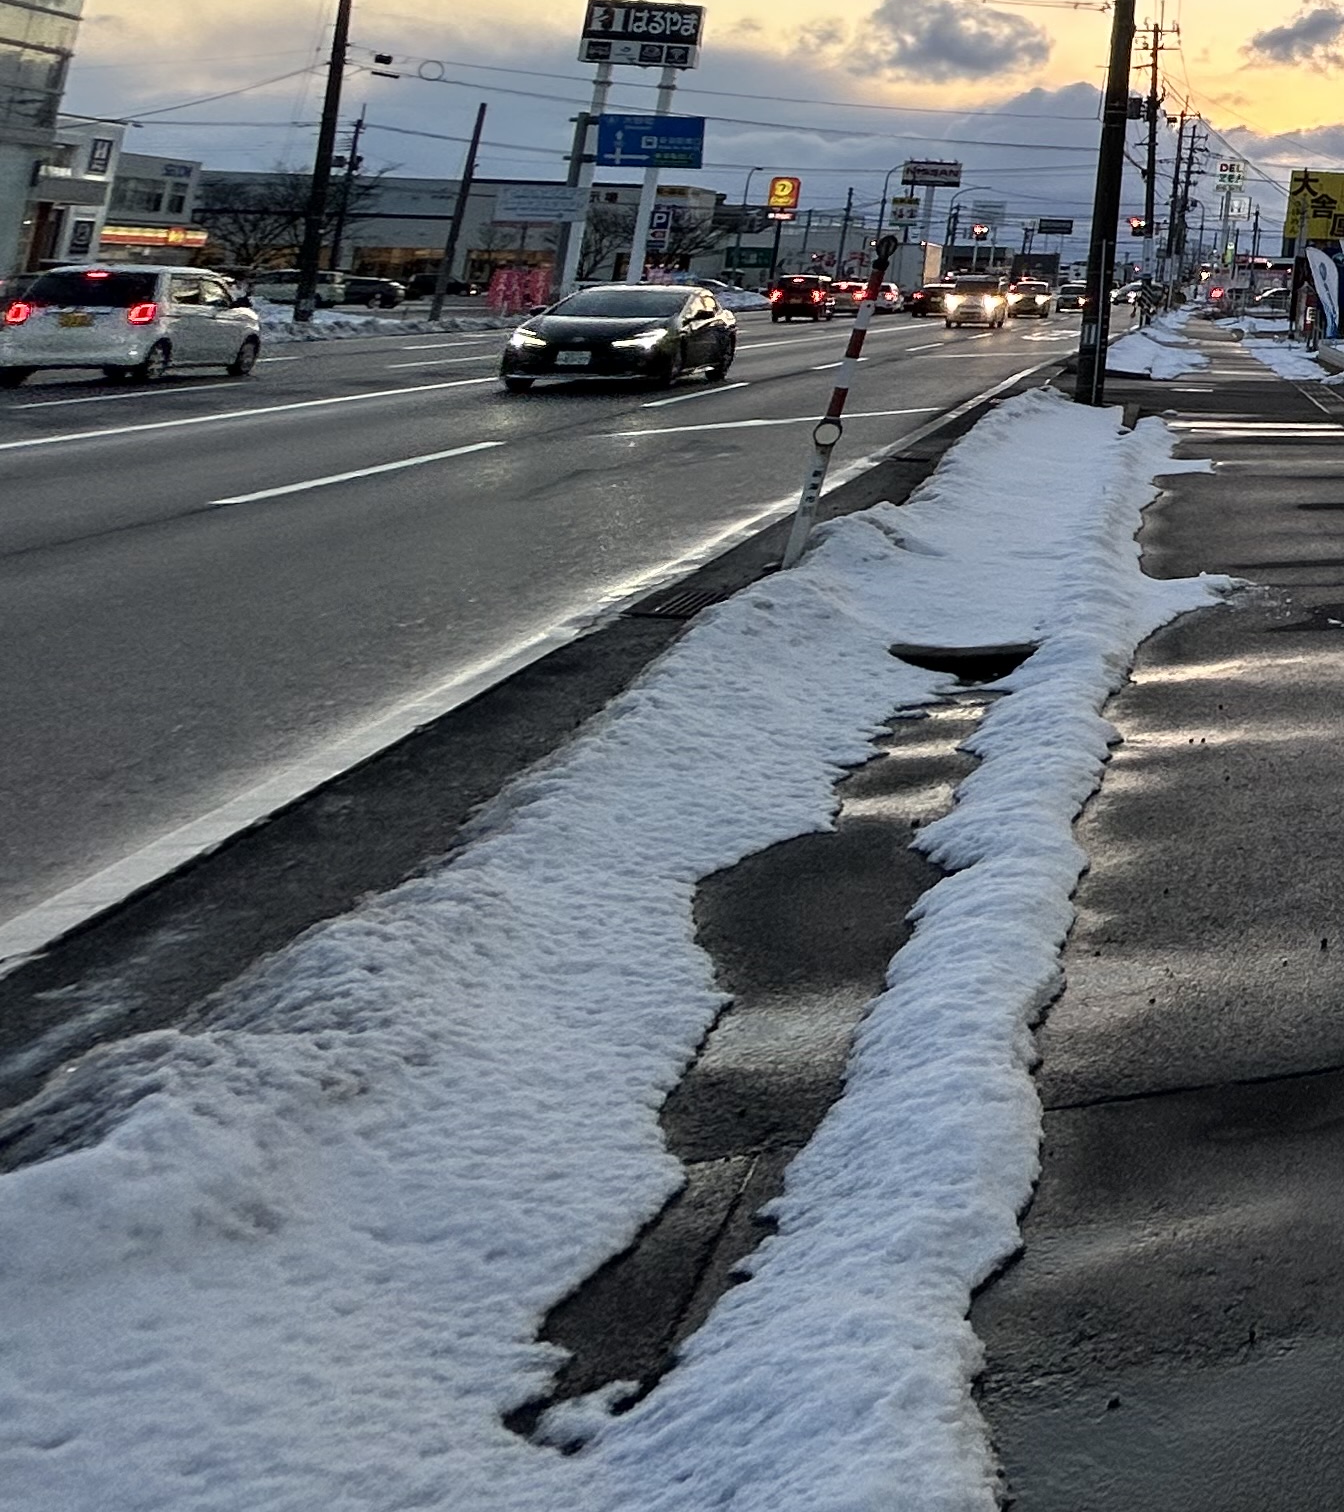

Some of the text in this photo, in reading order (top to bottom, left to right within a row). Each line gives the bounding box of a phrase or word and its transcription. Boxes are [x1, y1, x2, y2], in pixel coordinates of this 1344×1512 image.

[627, 8, 699, 36] はるやま
[905, 165, 960, 179] NISSAN
[653, 213, 667, 228] P
